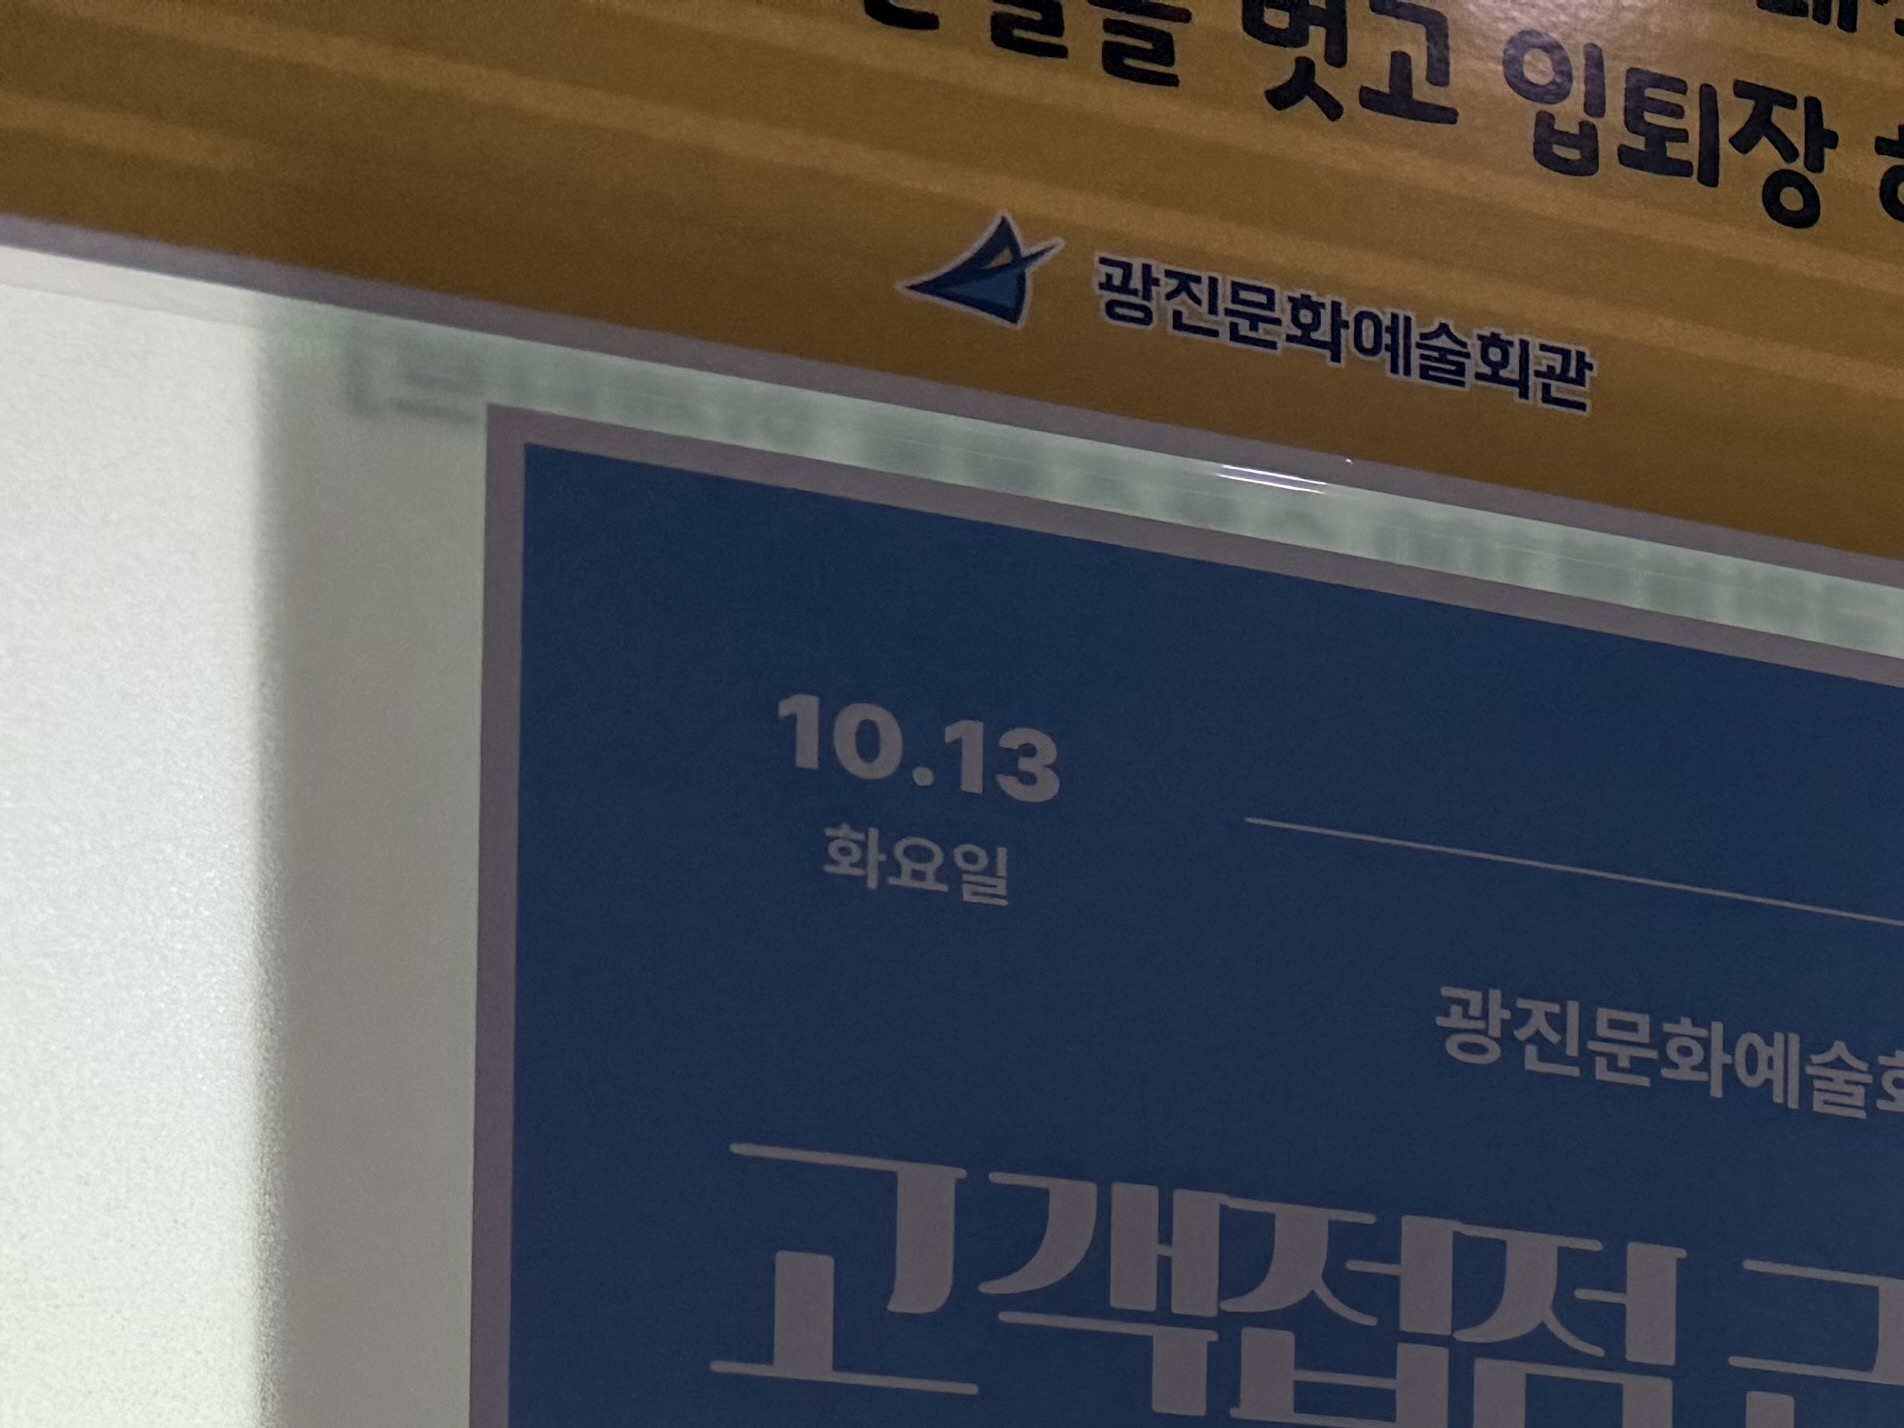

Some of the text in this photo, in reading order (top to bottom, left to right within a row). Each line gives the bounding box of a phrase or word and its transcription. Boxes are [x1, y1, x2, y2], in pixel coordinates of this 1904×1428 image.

[1241, 0, 1459, 125] 벗고
[1501, 29, 1839, 230] 입퇴장
[1096, 255, 1597, 413] 광진문화예술회관
[777, 693, 1061, 803] 10.13
[823, 822, 1010, 908] 화요일
